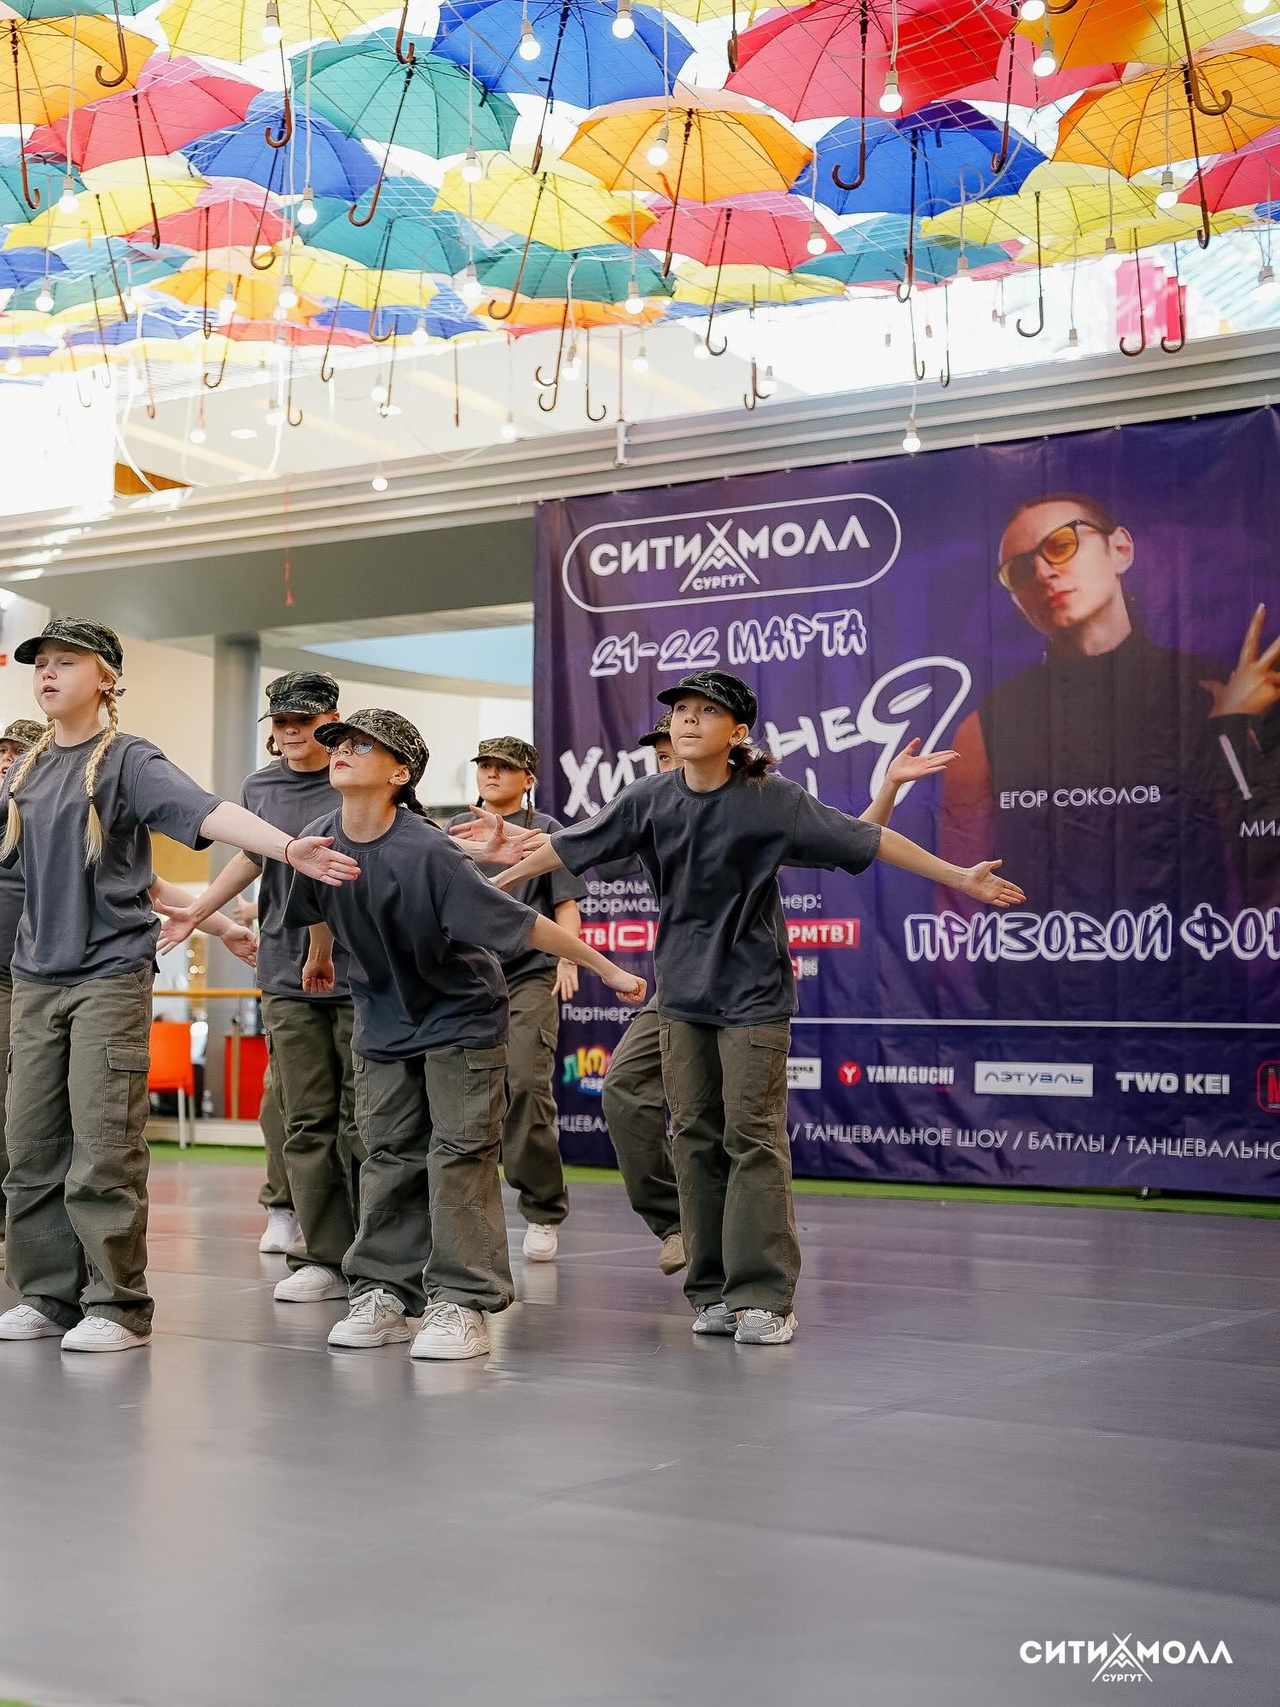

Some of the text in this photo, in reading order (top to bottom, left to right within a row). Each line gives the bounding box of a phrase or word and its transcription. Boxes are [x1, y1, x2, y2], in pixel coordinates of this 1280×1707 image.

[691, 572, 747, 591] СУРГУТ
[589, 608, 867, 678] 21-22 МАРТА
[999, 785, 1161, 809] ЕГОР СОКОЛОВ
[1238, 819, 1280, 838] МИ
[903, 902, 1172, 962] ПРИЗОВОЙ
[866, 1065, 955, 1085] YAMAGUCHI
[1115, 1071, 1231, 1095] TWO KEI
[804, 1122, 952, 1147] ТАНЦЕВАЛЬНОЕ
[956, 1128, 1008, 1149] ШОУ
[1027, 1131, 1105, 1153] БАТТЛЫ
